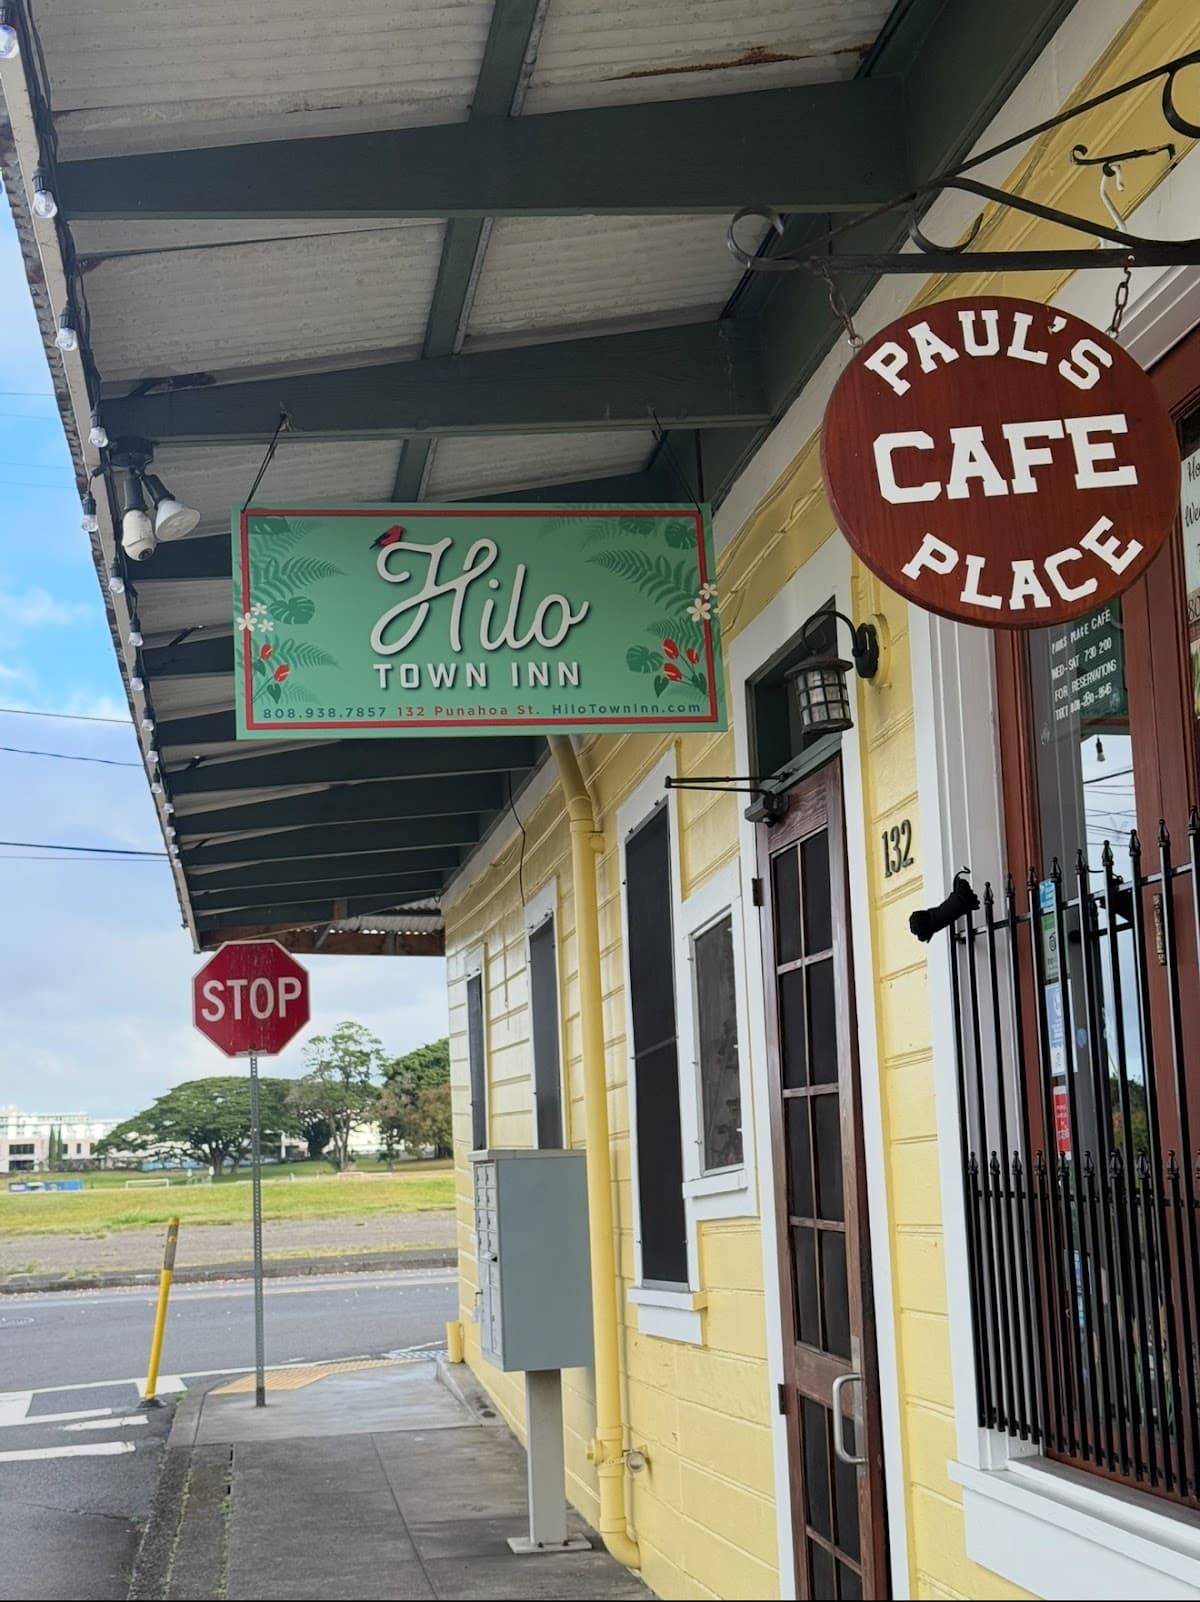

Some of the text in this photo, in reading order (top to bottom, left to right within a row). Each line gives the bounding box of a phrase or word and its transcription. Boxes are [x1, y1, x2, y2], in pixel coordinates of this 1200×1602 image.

[864, 309, 1113, 396] PAUL'S
[873, 414, 1138, 504] CAFE
[901, 515, 1144, 610] PLACE
[370, 537, 589, 656] Hilo
[1091, 608, 1111, 630] CAFE
[373, 661, 581, 690] TOWN INN
[1054, 659, 1117, 702] FOR RESERVATIONS
[263, 703, 701, 719] 808.938.7857 132 Punahoa St. HiloTownInn.com
[881, 819, 914, 878] 132
[201, 977, 302, 1022] STOP
